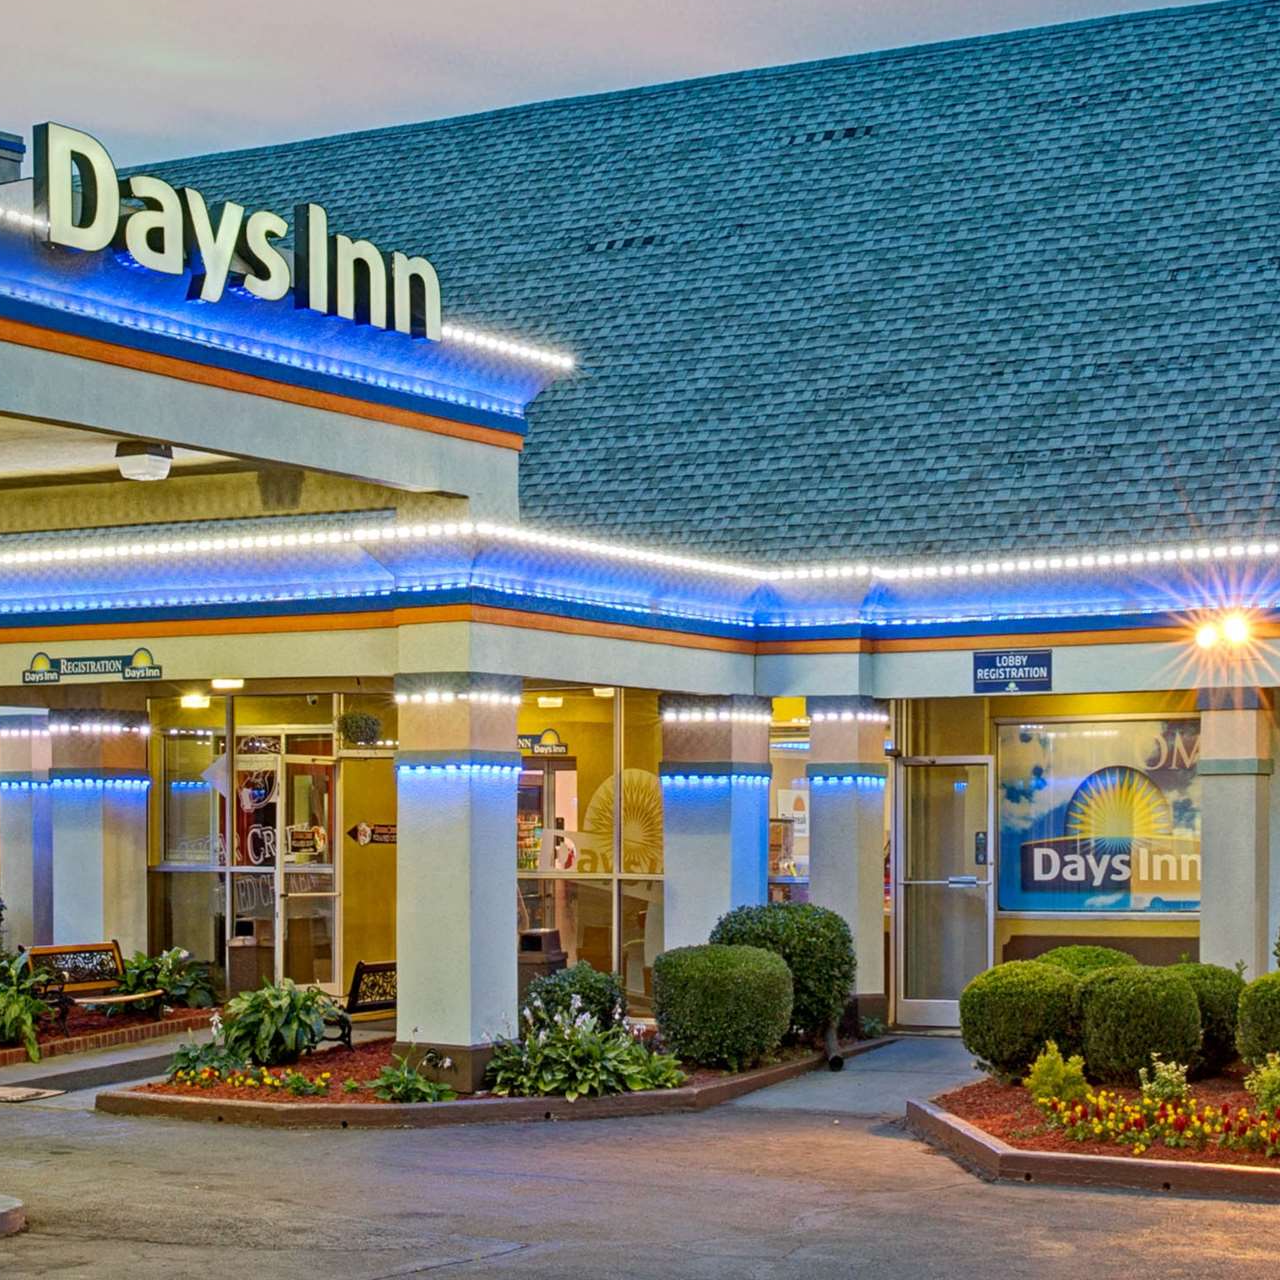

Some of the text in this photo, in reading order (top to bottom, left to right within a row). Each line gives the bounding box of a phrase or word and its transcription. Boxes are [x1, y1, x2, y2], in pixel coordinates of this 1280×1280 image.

[34, 121, 441, 341] Days Inn
[60, 659, 122, 674] REGISTRATION
[996, 656, 1028, 667] LOBBY
[25, 670, 59, 682] Days Inn
[125, 667, 161, 678] Days Inn
[977, 667, 1048, 679] REGISTRATION
[1033, 847, 1201, 887] Days Inn
